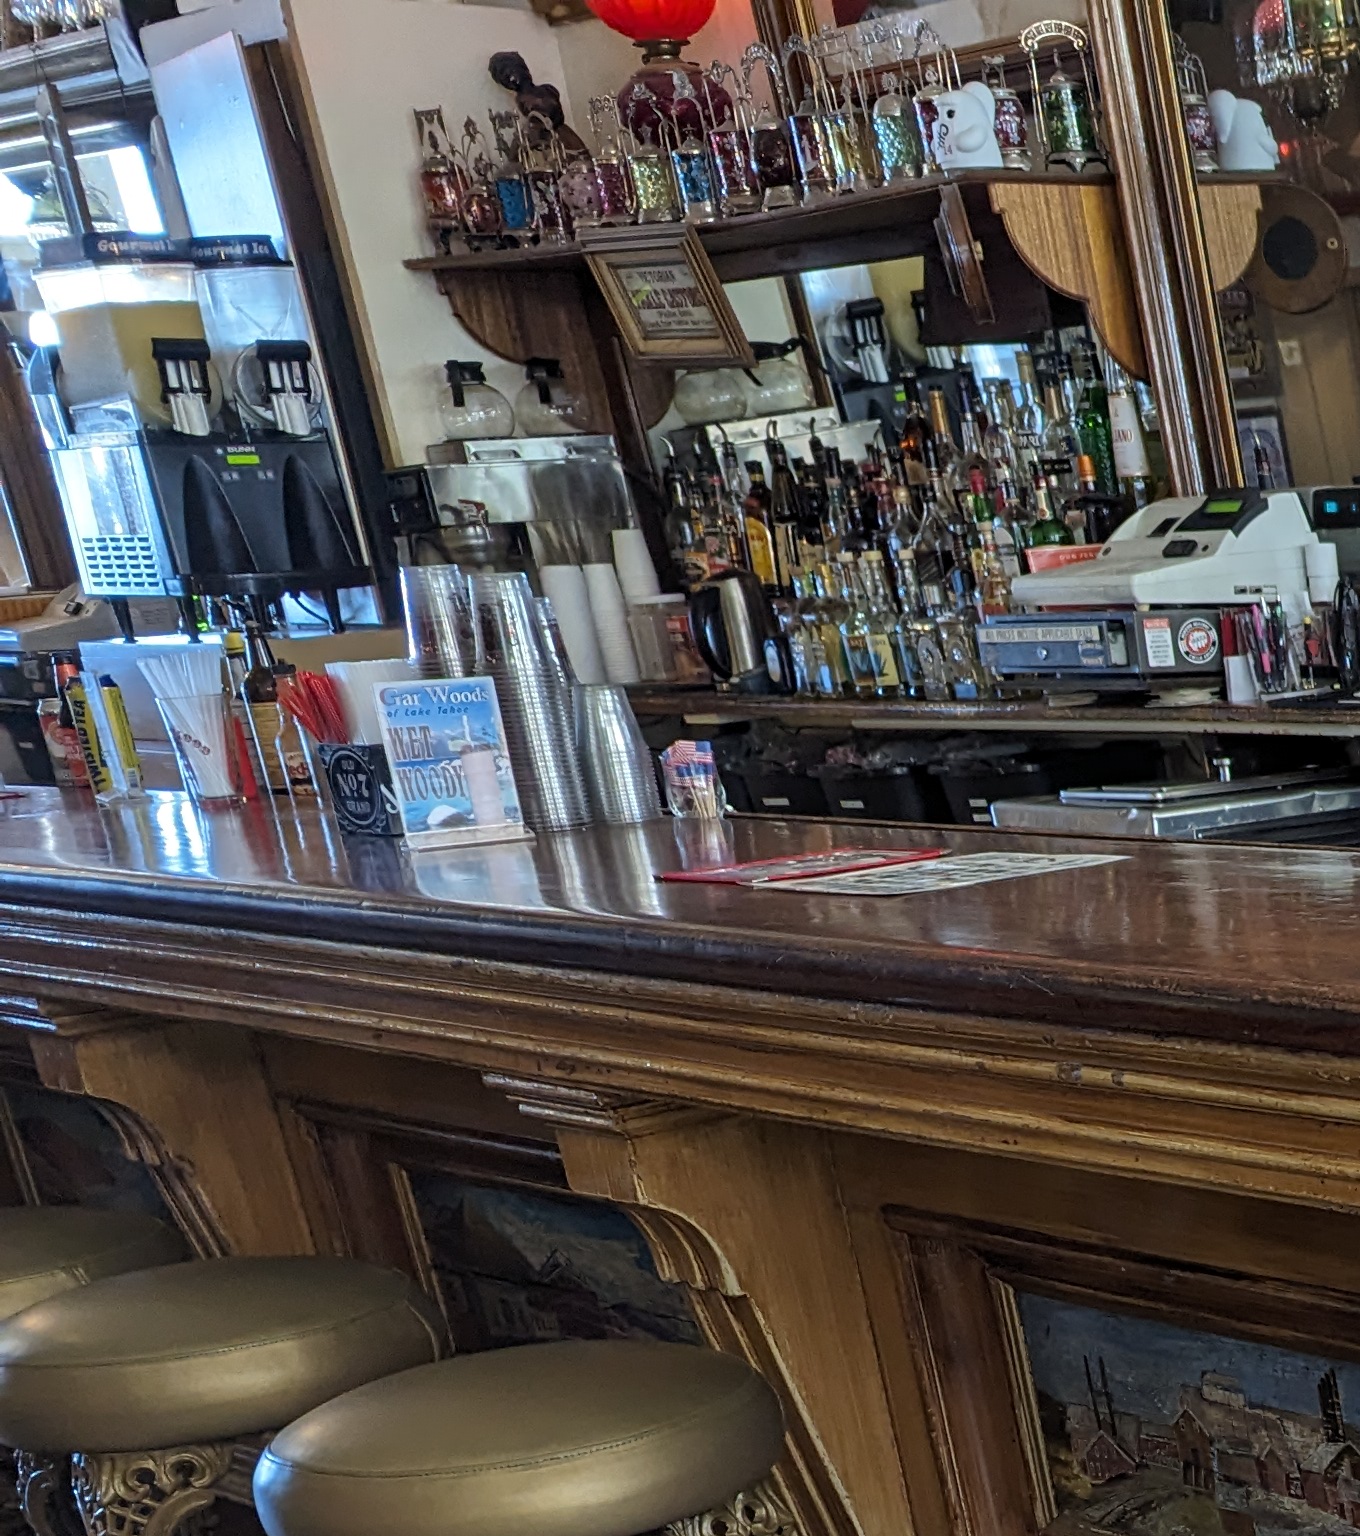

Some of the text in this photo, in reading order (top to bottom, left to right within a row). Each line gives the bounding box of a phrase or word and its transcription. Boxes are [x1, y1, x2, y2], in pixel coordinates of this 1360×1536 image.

[379, 685, 491, 707] Gar Woods
[77, 699, 87, 725] TEA
[387, 706, 469, 719] of Lake Tahoe
[386, 725, 436, 762] WET
[395, 760, 470, 803] WOODY
